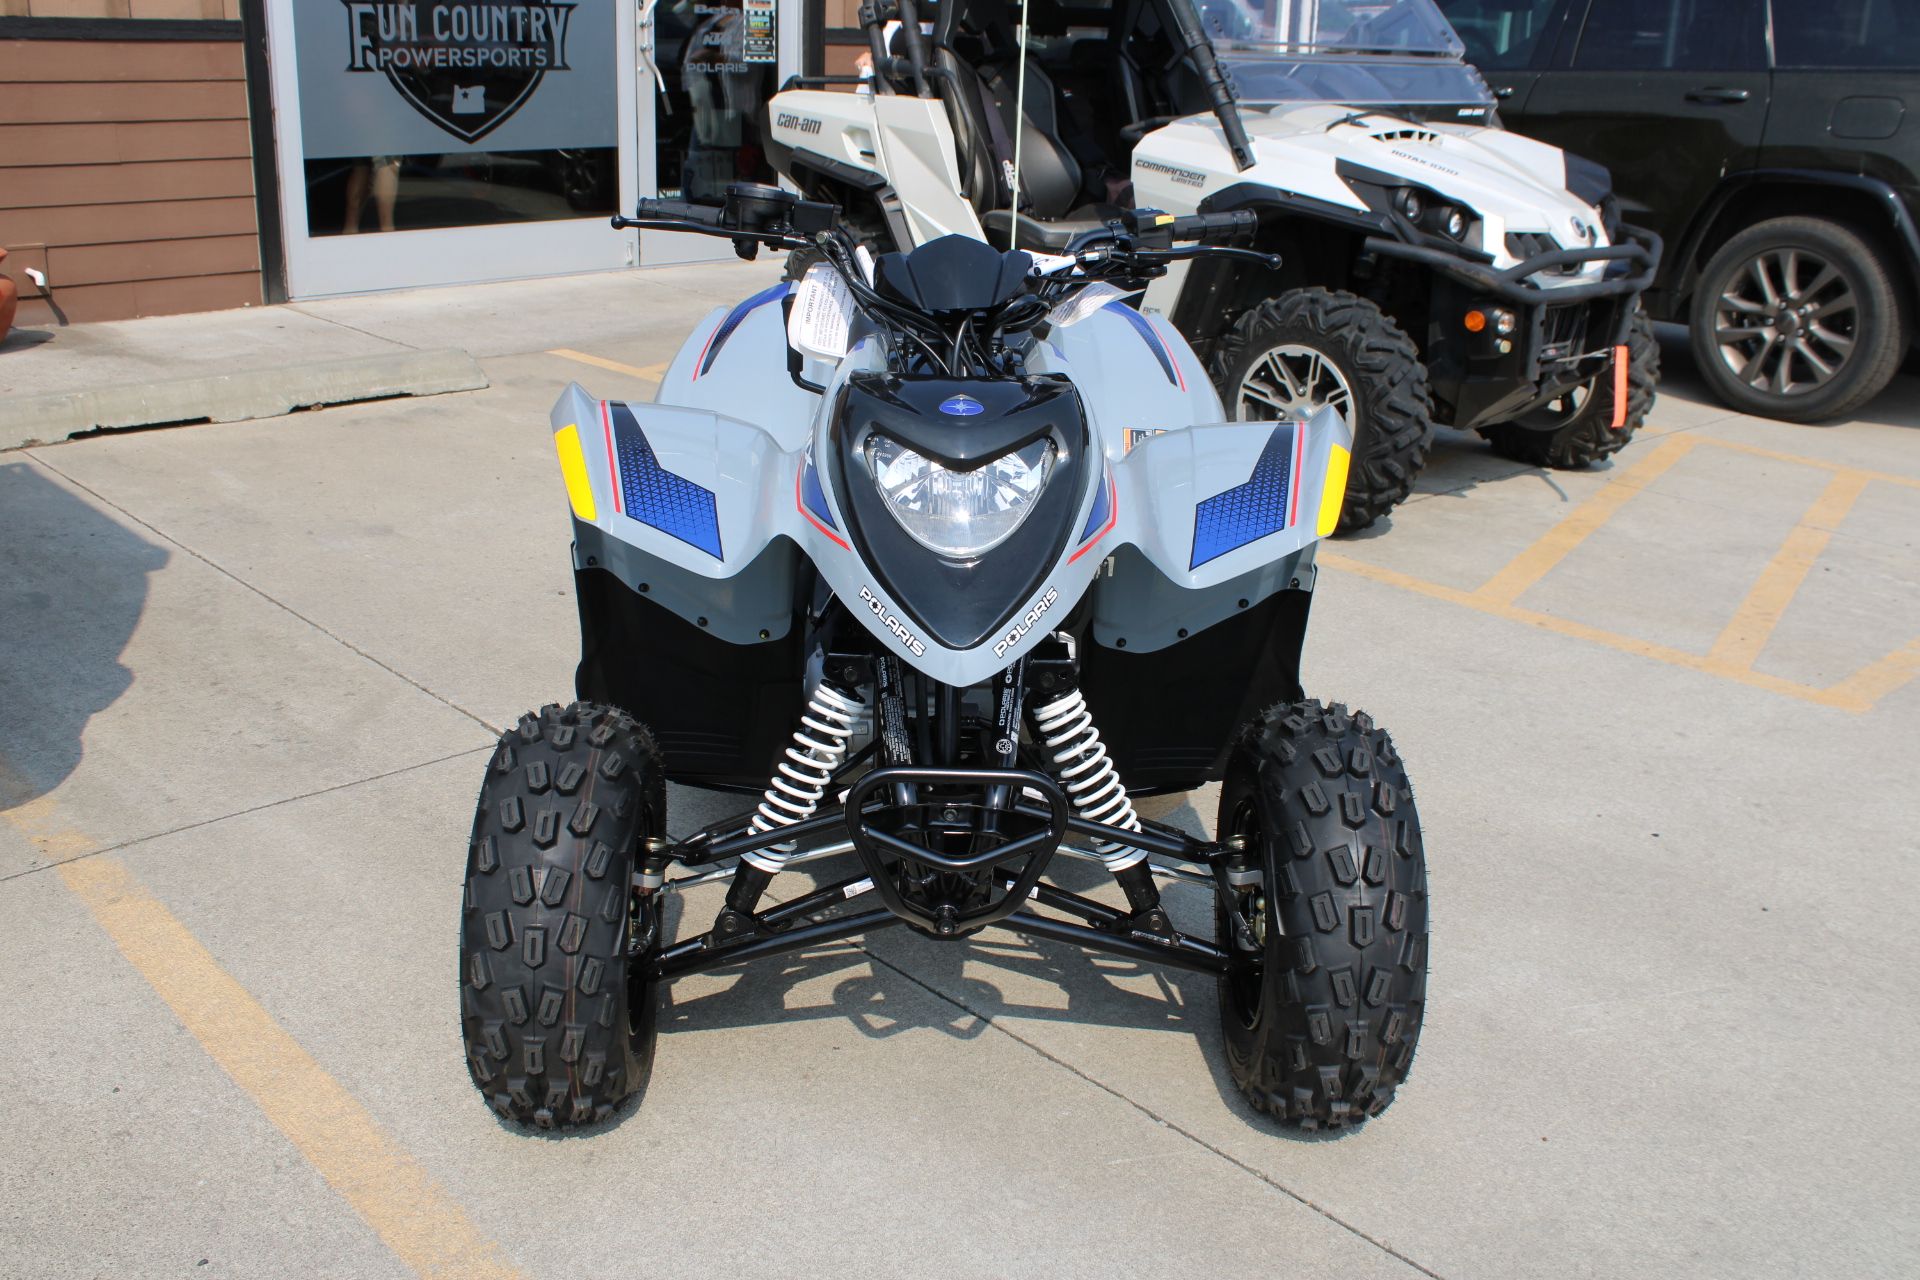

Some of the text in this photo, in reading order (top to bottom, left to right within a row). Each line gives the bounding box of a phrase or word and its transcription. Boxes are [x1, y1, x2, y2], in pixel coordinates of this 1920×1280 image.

[351, 3, 569, 69] FUN COUNTRY
[379, 48, 547, 67] POWERSPORTS
[686, 62, 748, 72] POLARIS
[1135, 159, 1207, 181] COMMANDER
[1171, 175, 1204, 188] LIMITED
[805, 284, 817, 325] IMPORTANT
[858, 585, 926, 657] POLARIS
[992, 586, 1058, 659] POLARIS
